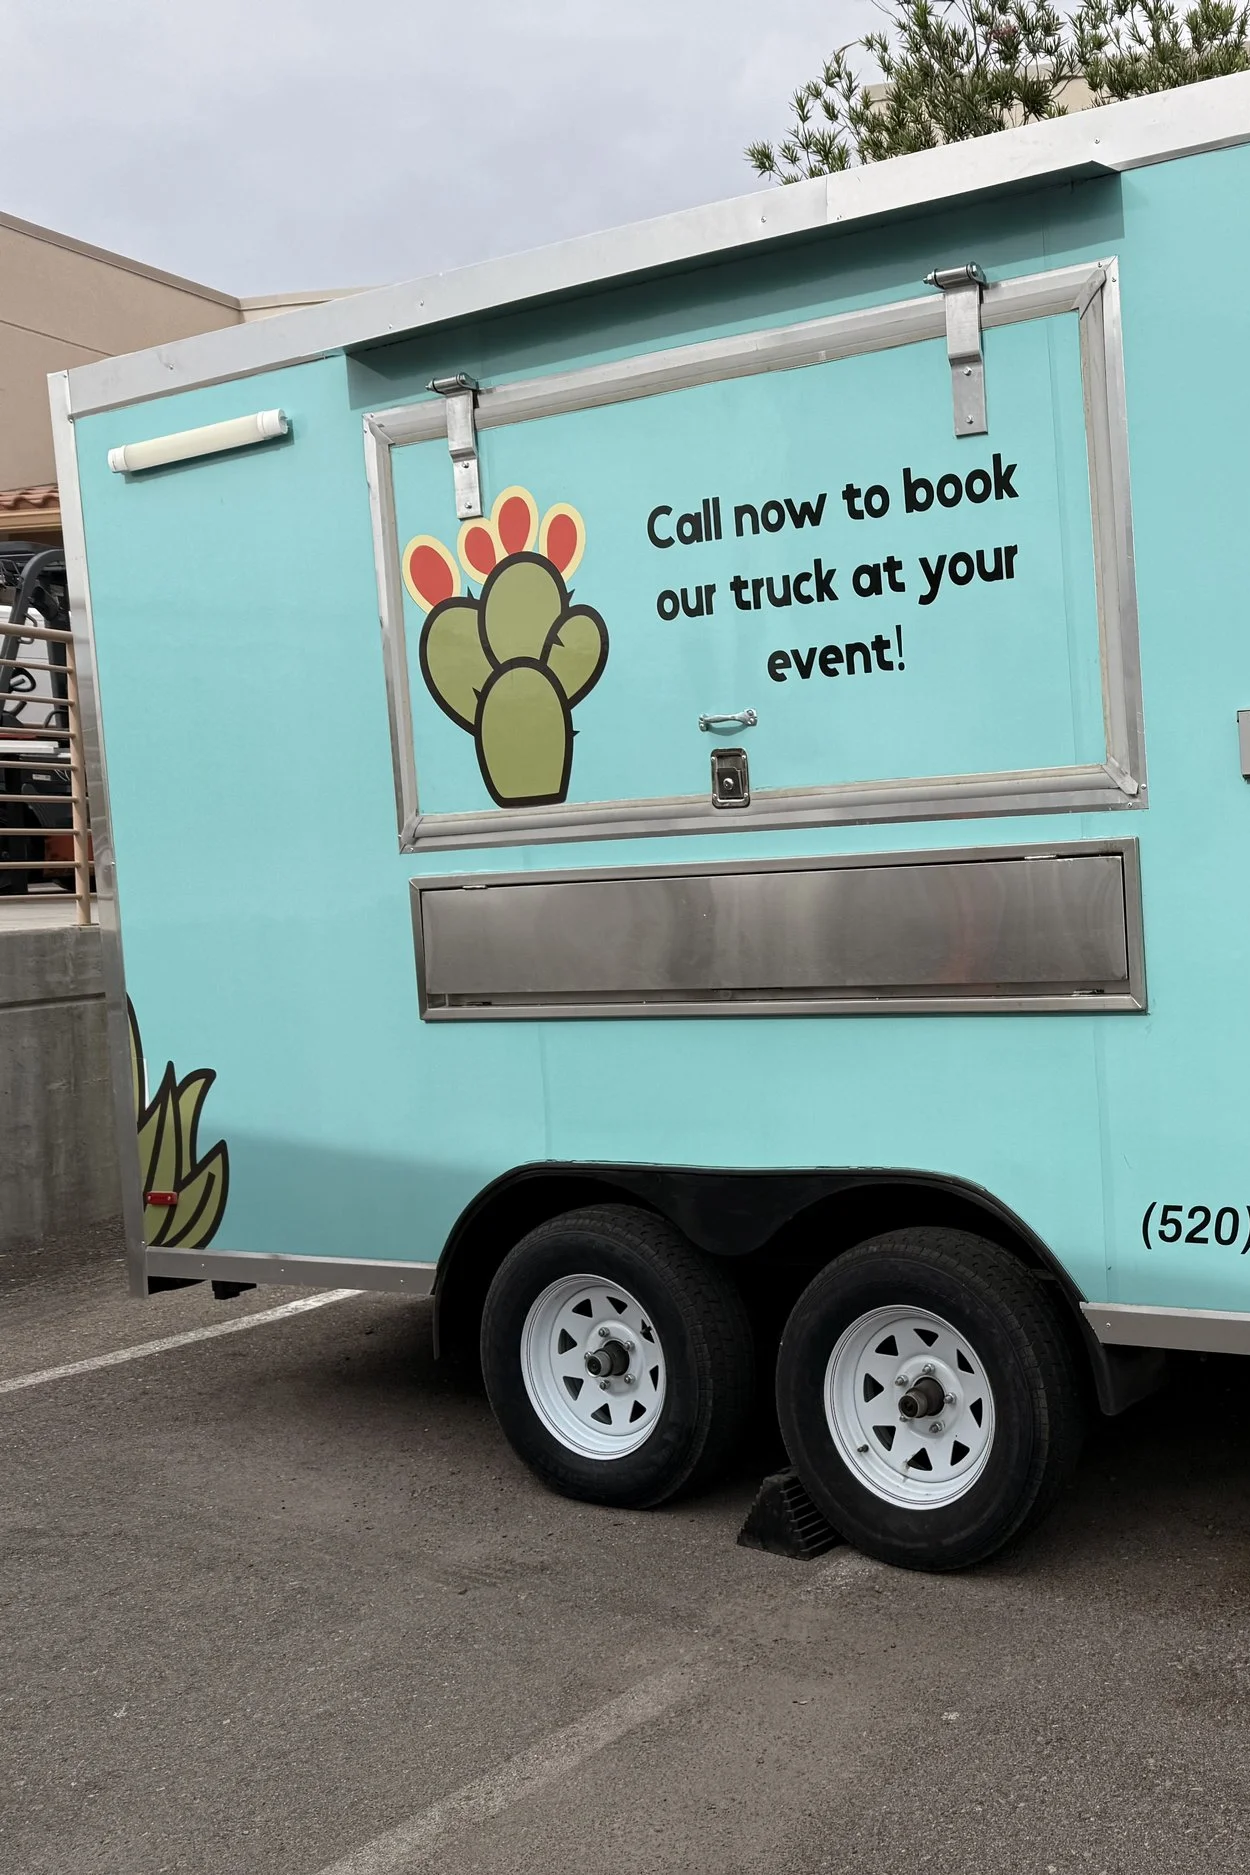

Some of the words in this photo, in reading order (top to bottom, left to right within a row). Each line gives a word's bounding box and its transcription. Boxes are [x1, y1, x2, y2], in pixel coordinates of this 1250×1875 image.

[647, 497, 723, 549] Call
[734, 493, 828, 540] now
[841, 483, 890, 520] to
[902, 452, 1020, 514] book
[656, 583, 717, 621] our
[729, 558, 839, 611] truck
[851, 555, 906, 598] at
[918, 544, 1018, 606] your
[767, 624, 906, 683] event!
